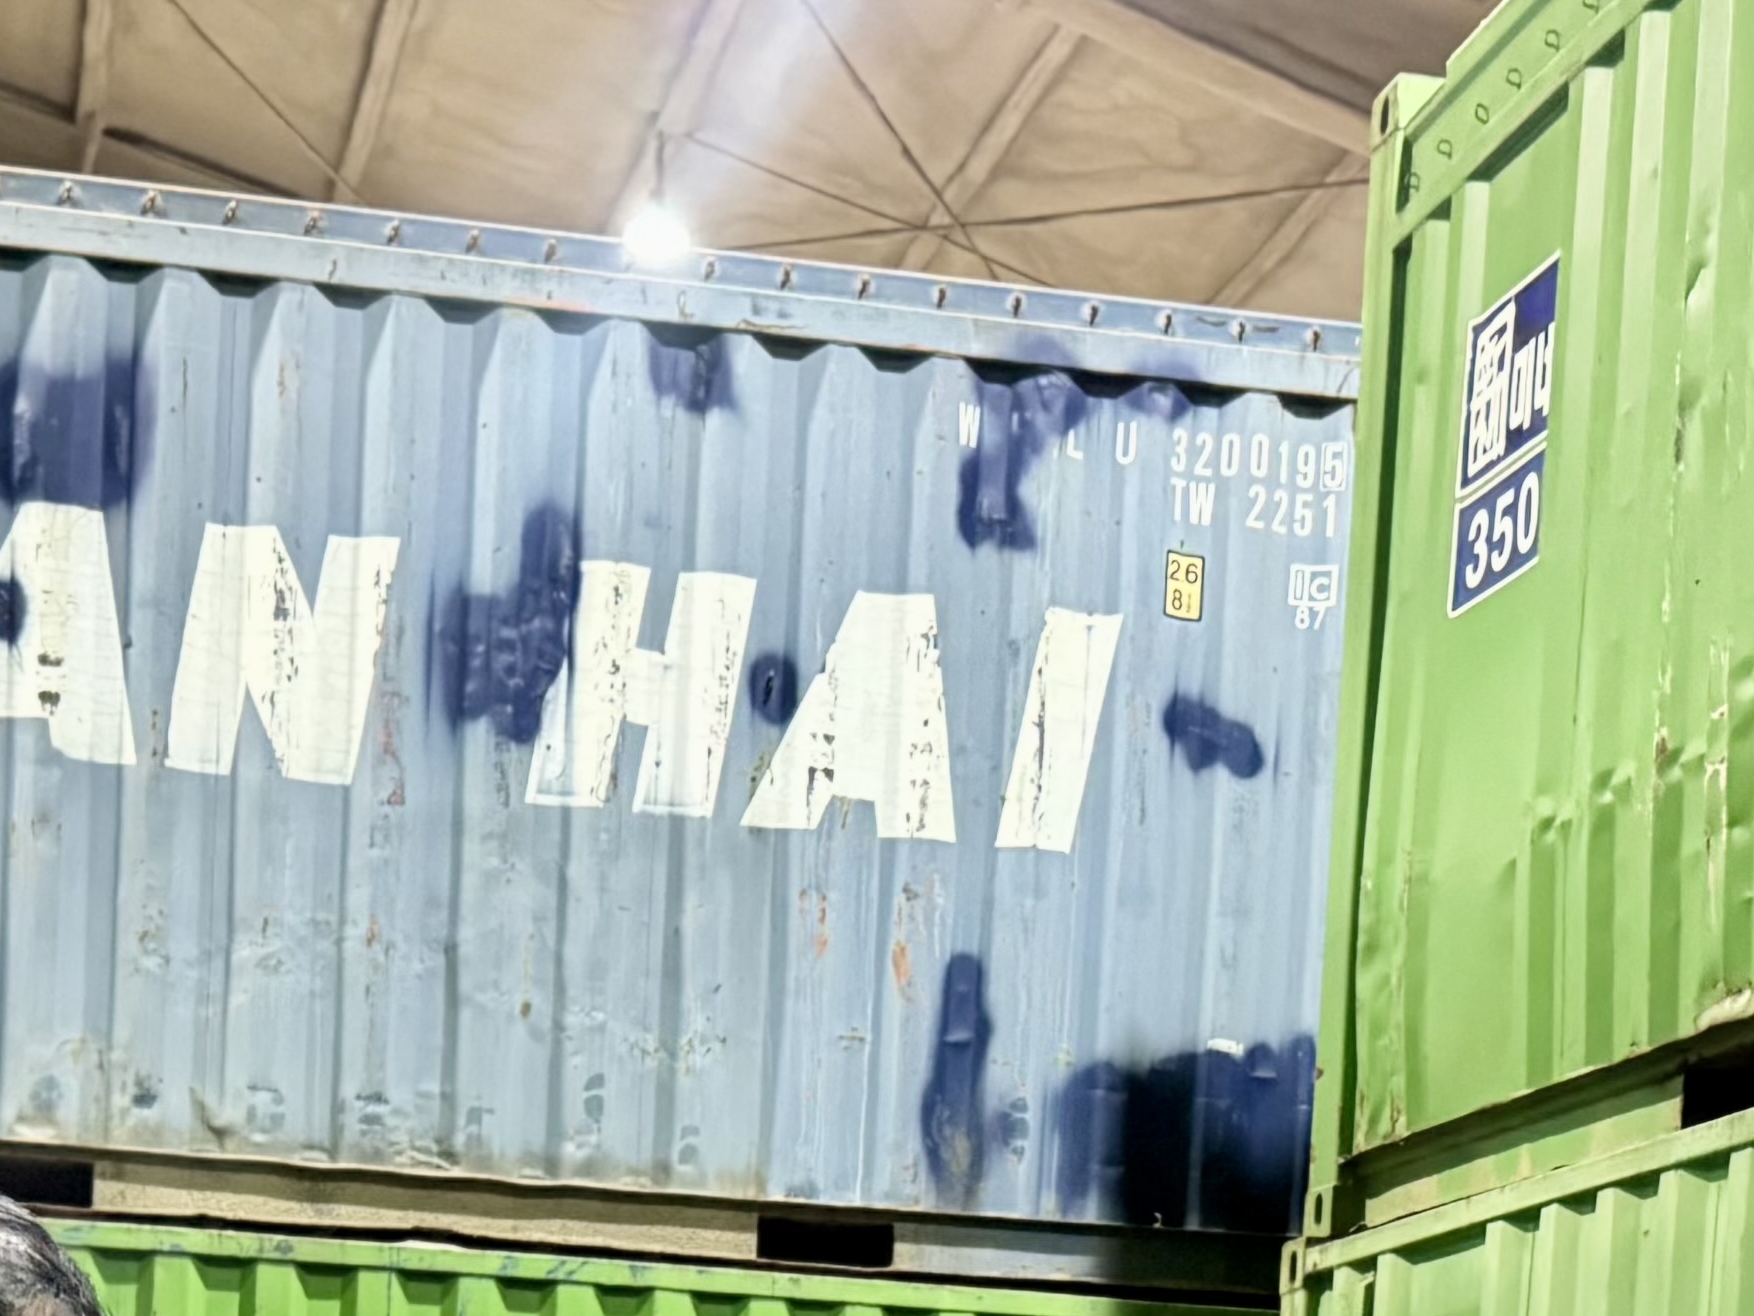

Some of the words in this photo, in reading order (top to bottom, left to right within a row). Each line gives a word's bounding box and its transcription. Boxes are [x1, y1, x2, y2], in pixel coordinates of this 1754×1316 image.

[1169, 477, 1216, 526] TW
[1245, 483, 1337, 538] 2251
[1464, 470, 1541, 590] 350
[1294, 606, 1326, 630] 87
[524, 559, 1123, 854] HAI
